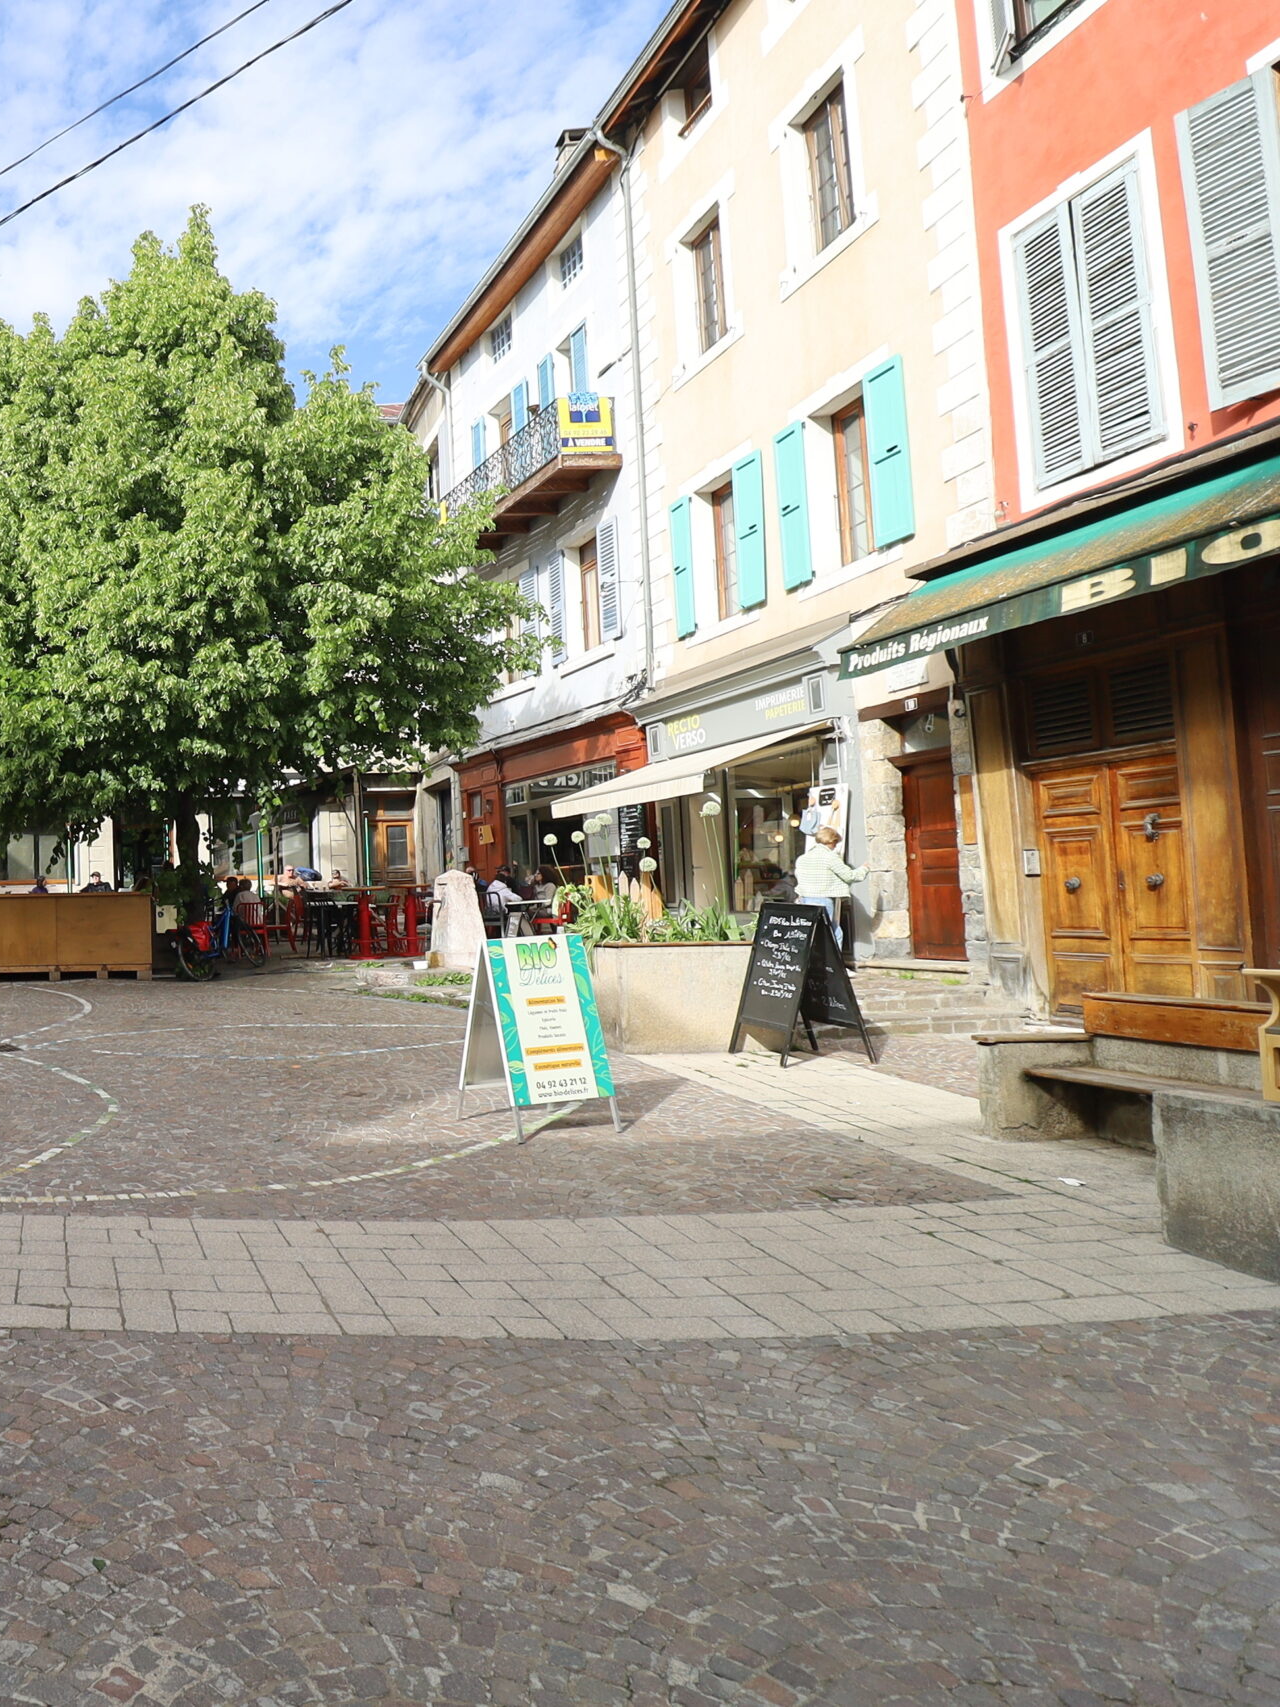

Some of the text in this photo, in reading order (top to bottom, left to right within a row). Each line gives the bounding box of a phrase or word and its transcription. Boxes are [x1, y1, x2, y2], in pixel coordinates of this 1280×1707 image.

[575, 438, 606, 447] VENDRE
[1061, 519, 1280, 613] BIO
[848, 616, 990, 672] Produits Régionaux
[755, 686, 805, 711] IMPRIMERIE
[765, 699, 807, 720] PAPETERIE
[667, 715, 700, 736] RECTO
[672, 728, 706, 750] VERSO
[516, 942, 557, 970] BIO
[536, 1077, 587, 1089] 04 92 43 21 12
